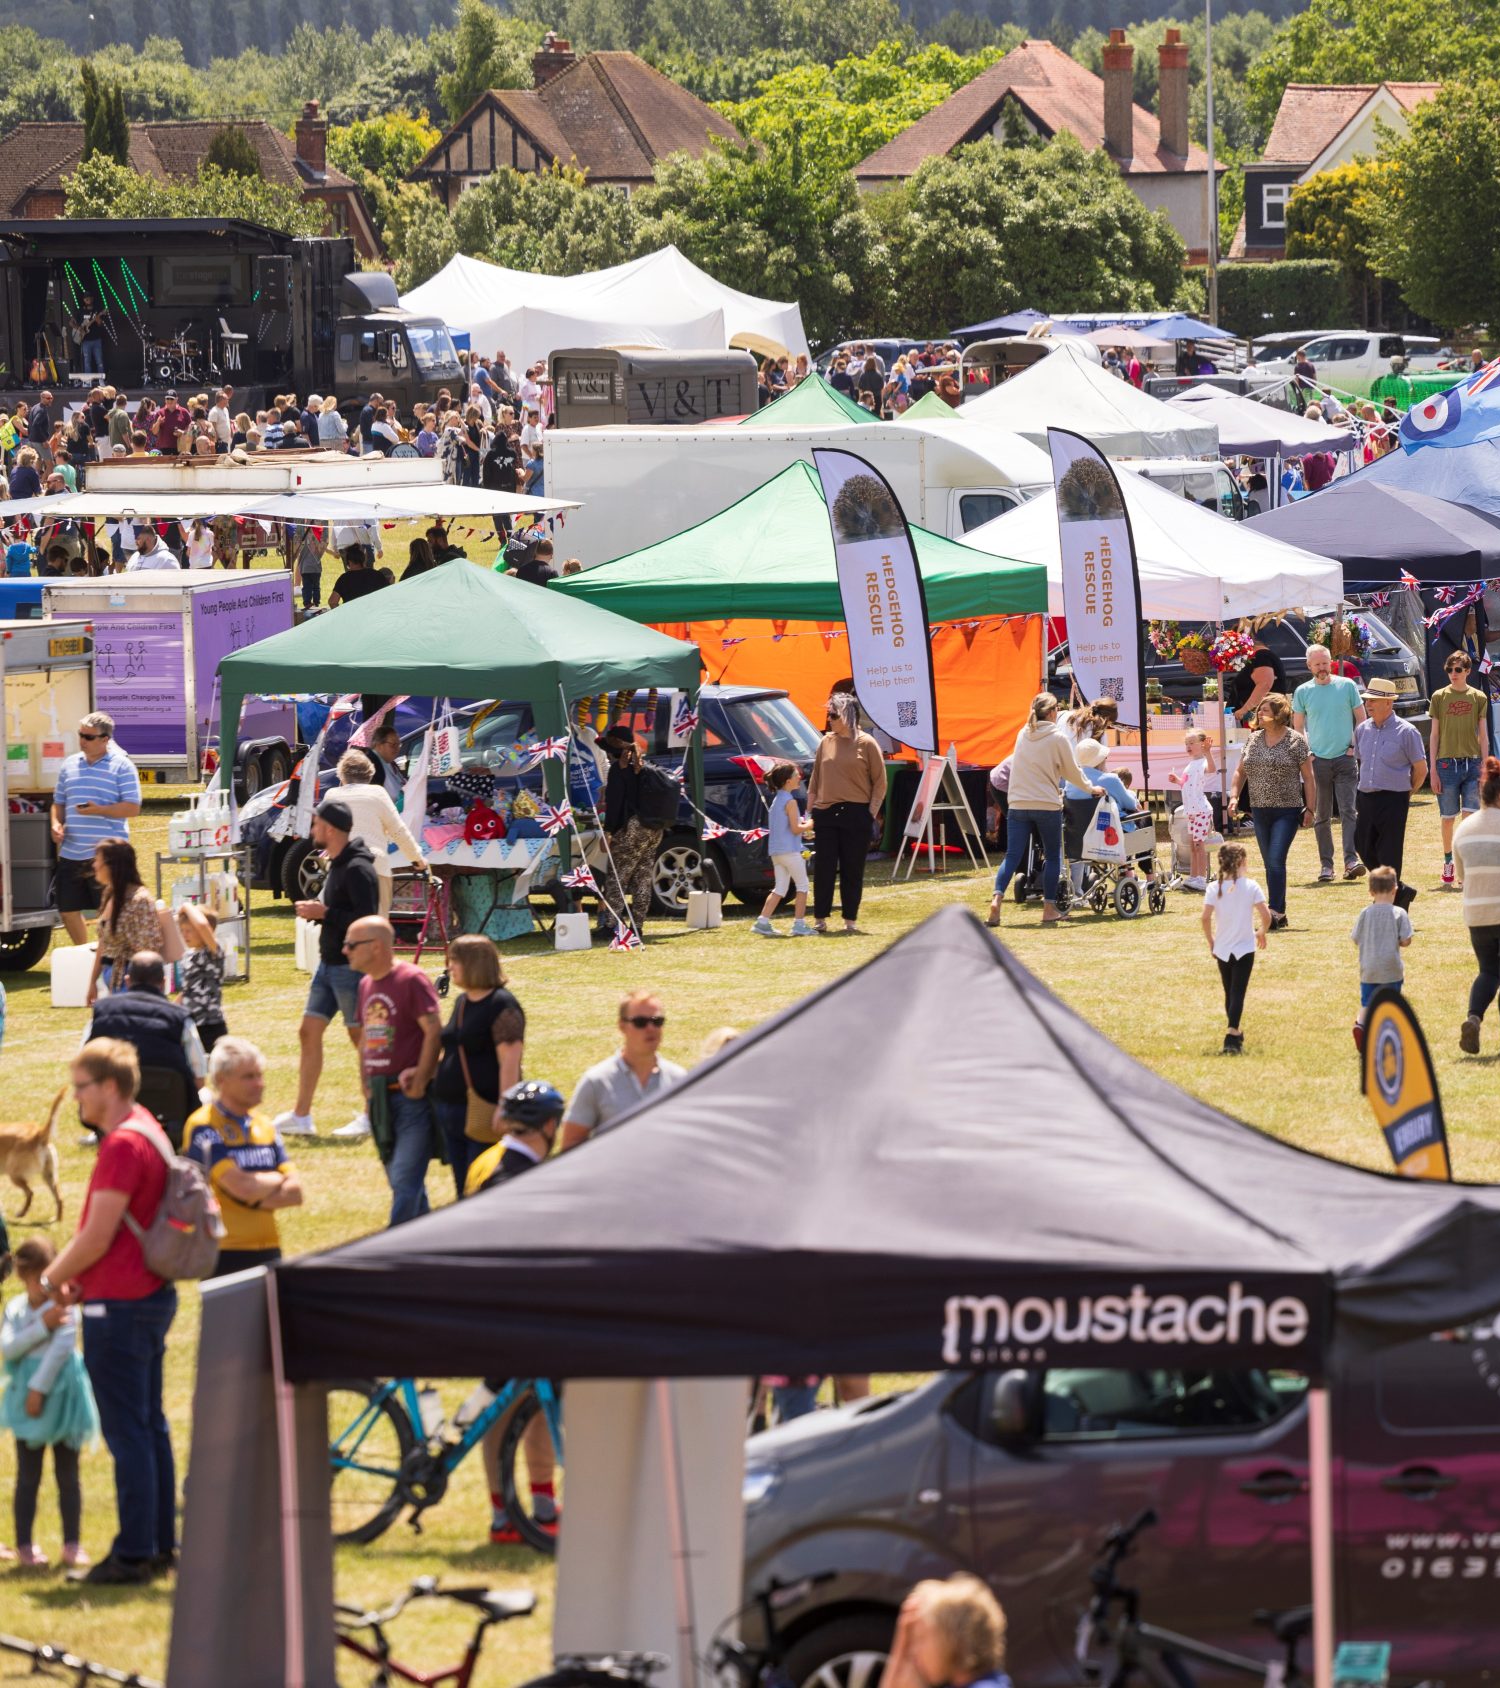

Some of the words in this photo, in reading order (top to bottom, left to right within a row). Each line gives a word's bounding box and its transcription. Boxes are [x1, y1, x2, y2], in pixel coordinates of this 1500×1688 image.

[1085, 552, 1096, 615] RESCUE
[1100, 536, 1113, 627] HEDGEHOG
[200, 603, 217, 616] Young
[218, 599, 237, 614] People
[237, 597, 248, 609] And
[248, 593, 271, 607] Children
[272, 591, 284, 603] First
[866, 572, 884, 636] RESCUE
[881, 555, 904, 648] HEDGEHOG
[127, 623, 158, 631] Children
[1077, 643, 1096, 652] Help
[1098, 642, 1109, 650] us
[1111, 641, 1121, 650] to
[1079, 655, 1097, 664] Help
[1100, 654, 1123, 663] them
[867, 666, 888, 676] Help
[892, 663, 902, 673] us
[904, 663, 913, 671] to
[870, 679, 891, 689] Help
[894, 675, 915, 685] them
[942, 1281, 1309, 1364] moustache
